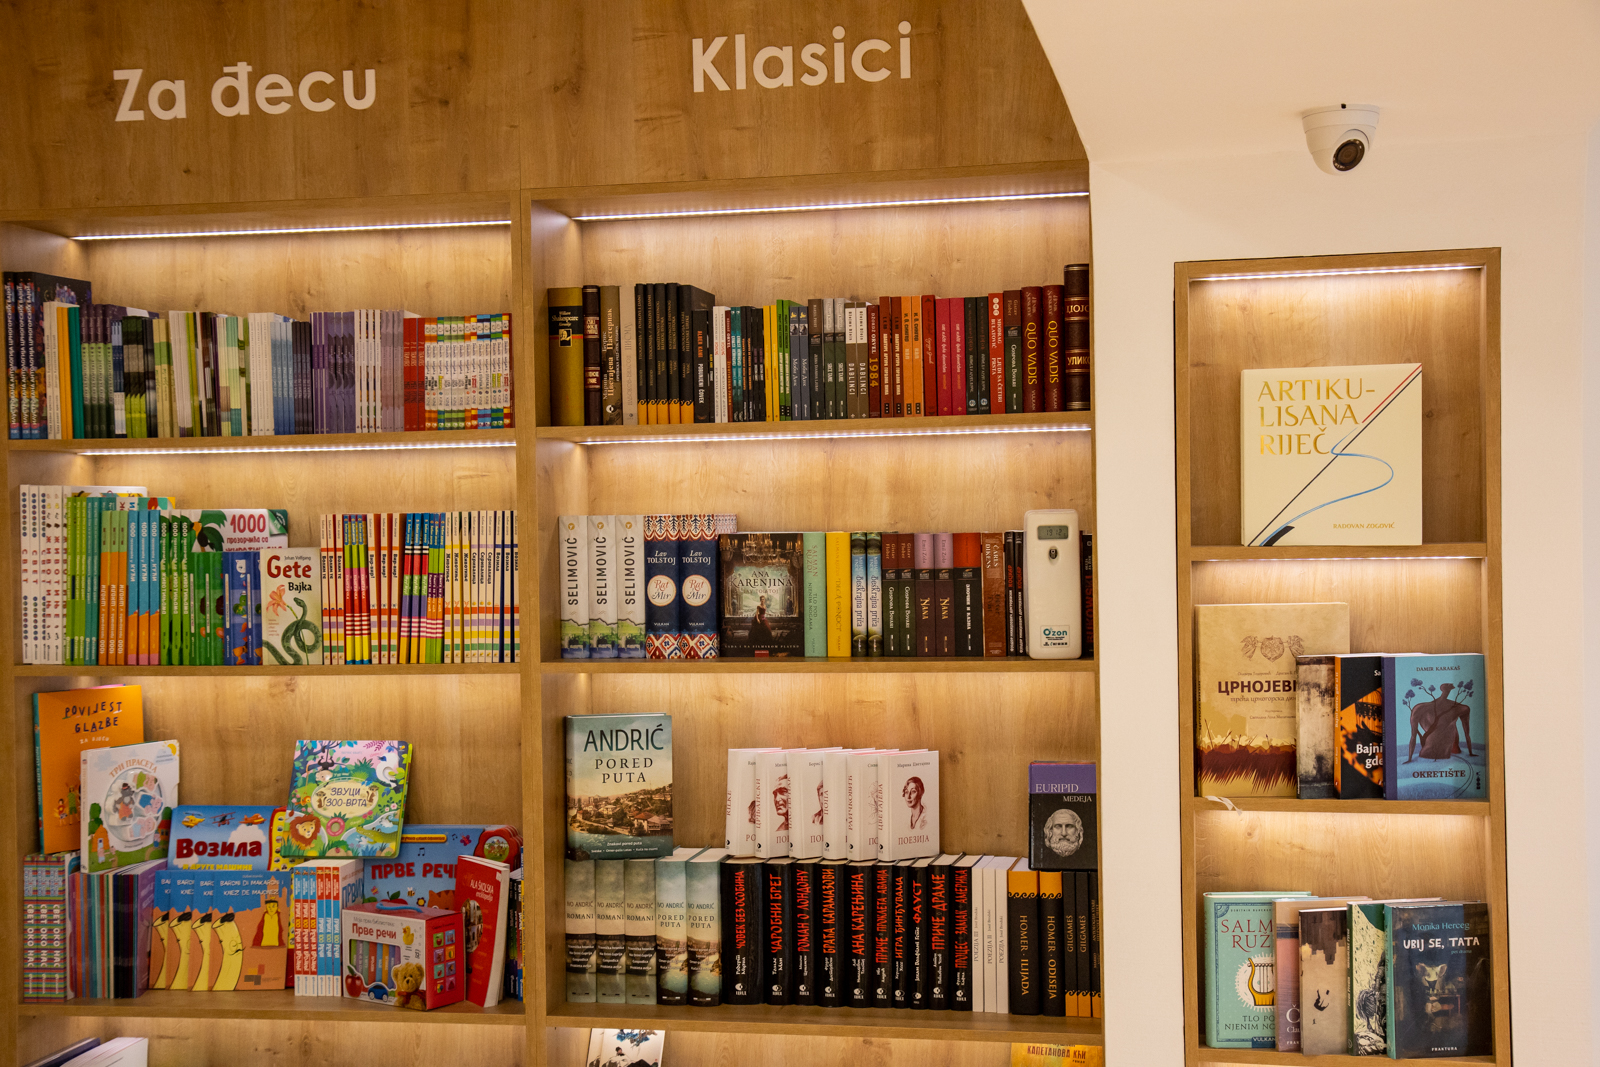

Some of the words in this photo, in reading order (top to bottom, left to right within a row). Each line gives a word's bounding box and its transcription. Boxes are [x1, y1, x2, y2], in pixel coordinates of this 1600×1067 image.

[691, 21, 913, 93] Klasici
[114, 68, 187, 121] Za
[211, 62, 377, 117] đecu
[1024, 322, 1037, 349] QUO
[1046, 320, 1058, 347] QUO
[869, 358, 879, 387] 1984
[1027, 352, 1037, 385] VADIS
[1049, 351, 1059, 383] VADIS
[1258, 378, 1375, 402] ARTIKU-
[1258, 404, 1360, 427] LISANA
[1259, 427, 1330, 456] RIJEČ
[229, 513, 266, 534] 1000
[226, 536, 260, 545] прозорчића
[267, 555, 312, 579] Gete
[565, 537, 578, 606] SELIMOVIĆ
[593, 536, 607, 605] SELIMOVIĆ
[622, 536, 636, 605] SELIMOVIĆ
[647, 557, 676, 565] TOLSTOJ
[682, 557, 711, 565] TOLSTOJ
[654, 580, 669, 591] Rat
[730, 577, 793, 588] KARENJINA
[751, 570, 770, 578] ANA
[288, 582, 312, 592] Bajka
[855, 610, 864, 627] priča
[920, 598, 930, 620] NANA
[940, 598, 950, 620] NANA
[1043, 627, 1067, 636] Ozon
[65, 702, 122, 718] POVIJEST
[75, 717, 118, 733] GLAZBE
[584, 723, 664, 752] ANDRIĆ
[1356, 743, 1383, 756] Bajni
[109, 764, 126, 777] ТРИ
[126, 759, 158, 773] ПРАСЕТА
[595, 757, 653, 769] PORED
[1365, 756, 1383, 768] gde
[1412, 768, 1466, 778] OKRETIŠTE
[602, 772, 646, 783] PUTA
[1035, 783, 1079, 793] EURIPID
[326, 797, 367, 807] ЗОО-ВРТА
[331, 787, 361, 797] ЗВУЦИ
[176, 838, 262, 858] Возила
[898, 835, 930, 845] ПОЕЗИЈА
[371, 862, 415, 879] ПРВЕ
[877, 870, 889, 894] АВЛИЈА
[735, 871, 745, 906] ОСОБИНА
[770, 874, 782, 900] БРЕГ
[796, 869, 811, 910] ЛОНДОНУ
[822, 868, 835, 924] КАРАМАЗОВИ
[932, 874, 947, 911] ДРАМЕ
[955, 870, 968, 904] АМЕРИКА
[851, 873, 865, 931] КАРЕЊИНА
[877, 897, 887, 931] ПРОКЛЕТА
[895, 877, 905, 933] ЂИНЂУВАМА
[913, 880, 922, 924] ФАУСТ
[658, 914, 684, 922] PORED
[736, 908, 745, 922] БЕЗ
[955, 910, 968, 934] ЗАМАК
[1221, 919, 1272, 933] SALM
[1412, 923, 1440, 931] Monika
[1442, 922, 1469, 930] Herceg
[352, 923, 374, 937] Прве
[376, 928, 397, 940] речи
[770, 903, 783, 953] ЧАРОБНИ
[798, 923, 810, 952] РОМАН
[932, 916, 945, 950] ПРИЧЕ
[1020, 915, 1028, 951] HOMER
[1047, 916, 1056, 951] HOMER
[1066, 915, 1074, 952] GILGAMEŠ
[1079, 915, 1087, 952] GILGAMEŠ
[822, 927, 835, 954] БРАЋА
[852, 933, 865, 955] АНА
[875, 937, 888, 963] ПРИЧЕ
[895, 936, 903, 958] ИГРА
[1403, 939, 1424, 951] UBIJ
[1428, 938, 1444, 949] SE,
[1449, 937, 1480, 947] TATA
[955, 941, 969, 968] ПРОЦЕС
[1020, 959, 1029, 995] ILIJADA
[1048, 959, 1057, 999] ODISEJA
